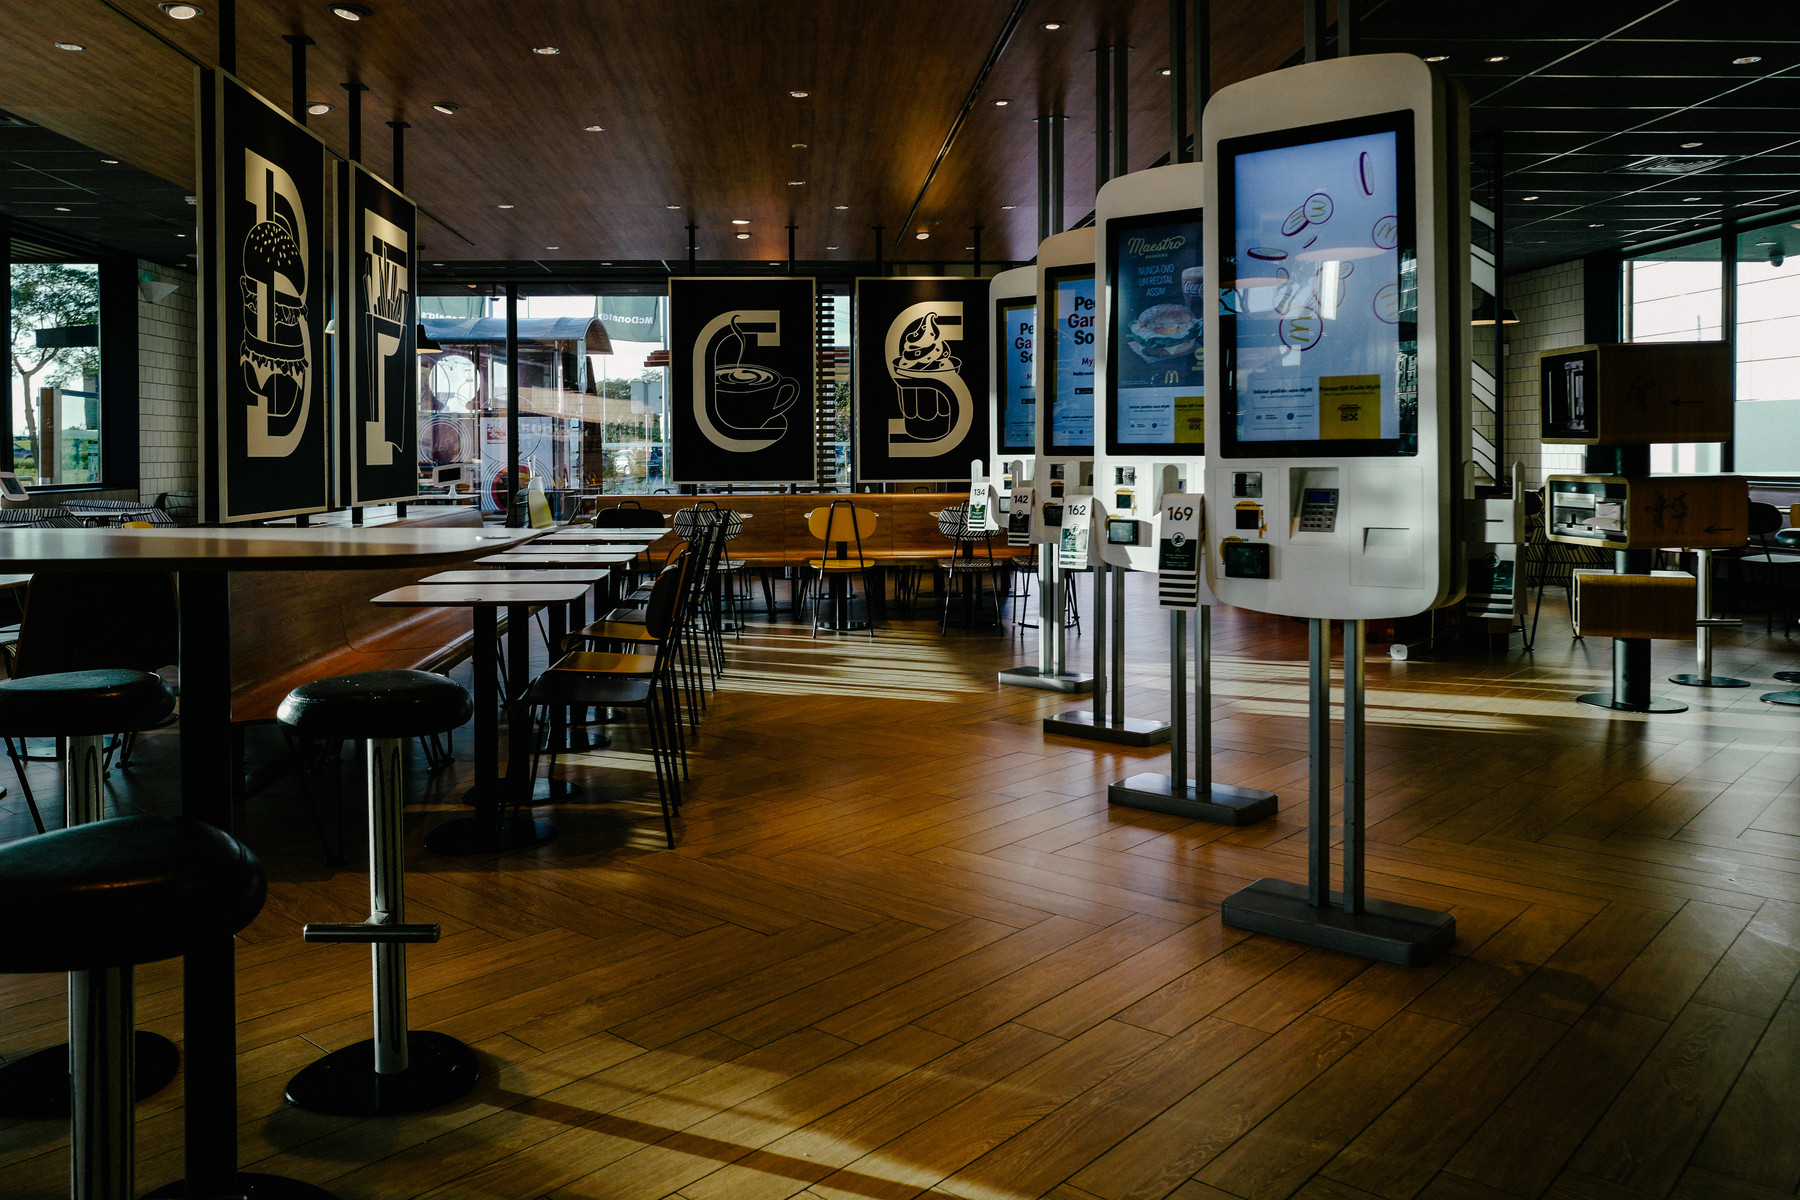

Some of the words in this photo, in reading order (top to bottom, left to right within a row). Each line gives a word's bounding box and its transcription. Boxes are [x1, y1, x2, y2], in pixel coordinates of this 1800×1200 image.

[1128, 235, 1186, 256] Maestro
[1138, 264, 1160, 275] NUNCA
[1138, 276, 1148, 286] UM
[1149, 275, 1174, 285] RECITAL
[1146, 287, 1166, 296] ASSIM
[1074, 330, 1095, 346] So
[885, 301, 974, 458] S
[1014, 495, 1028, 504] 142
[1068, 505, 1086, 516] 162
[1168, 506, 1194, 521] 169
